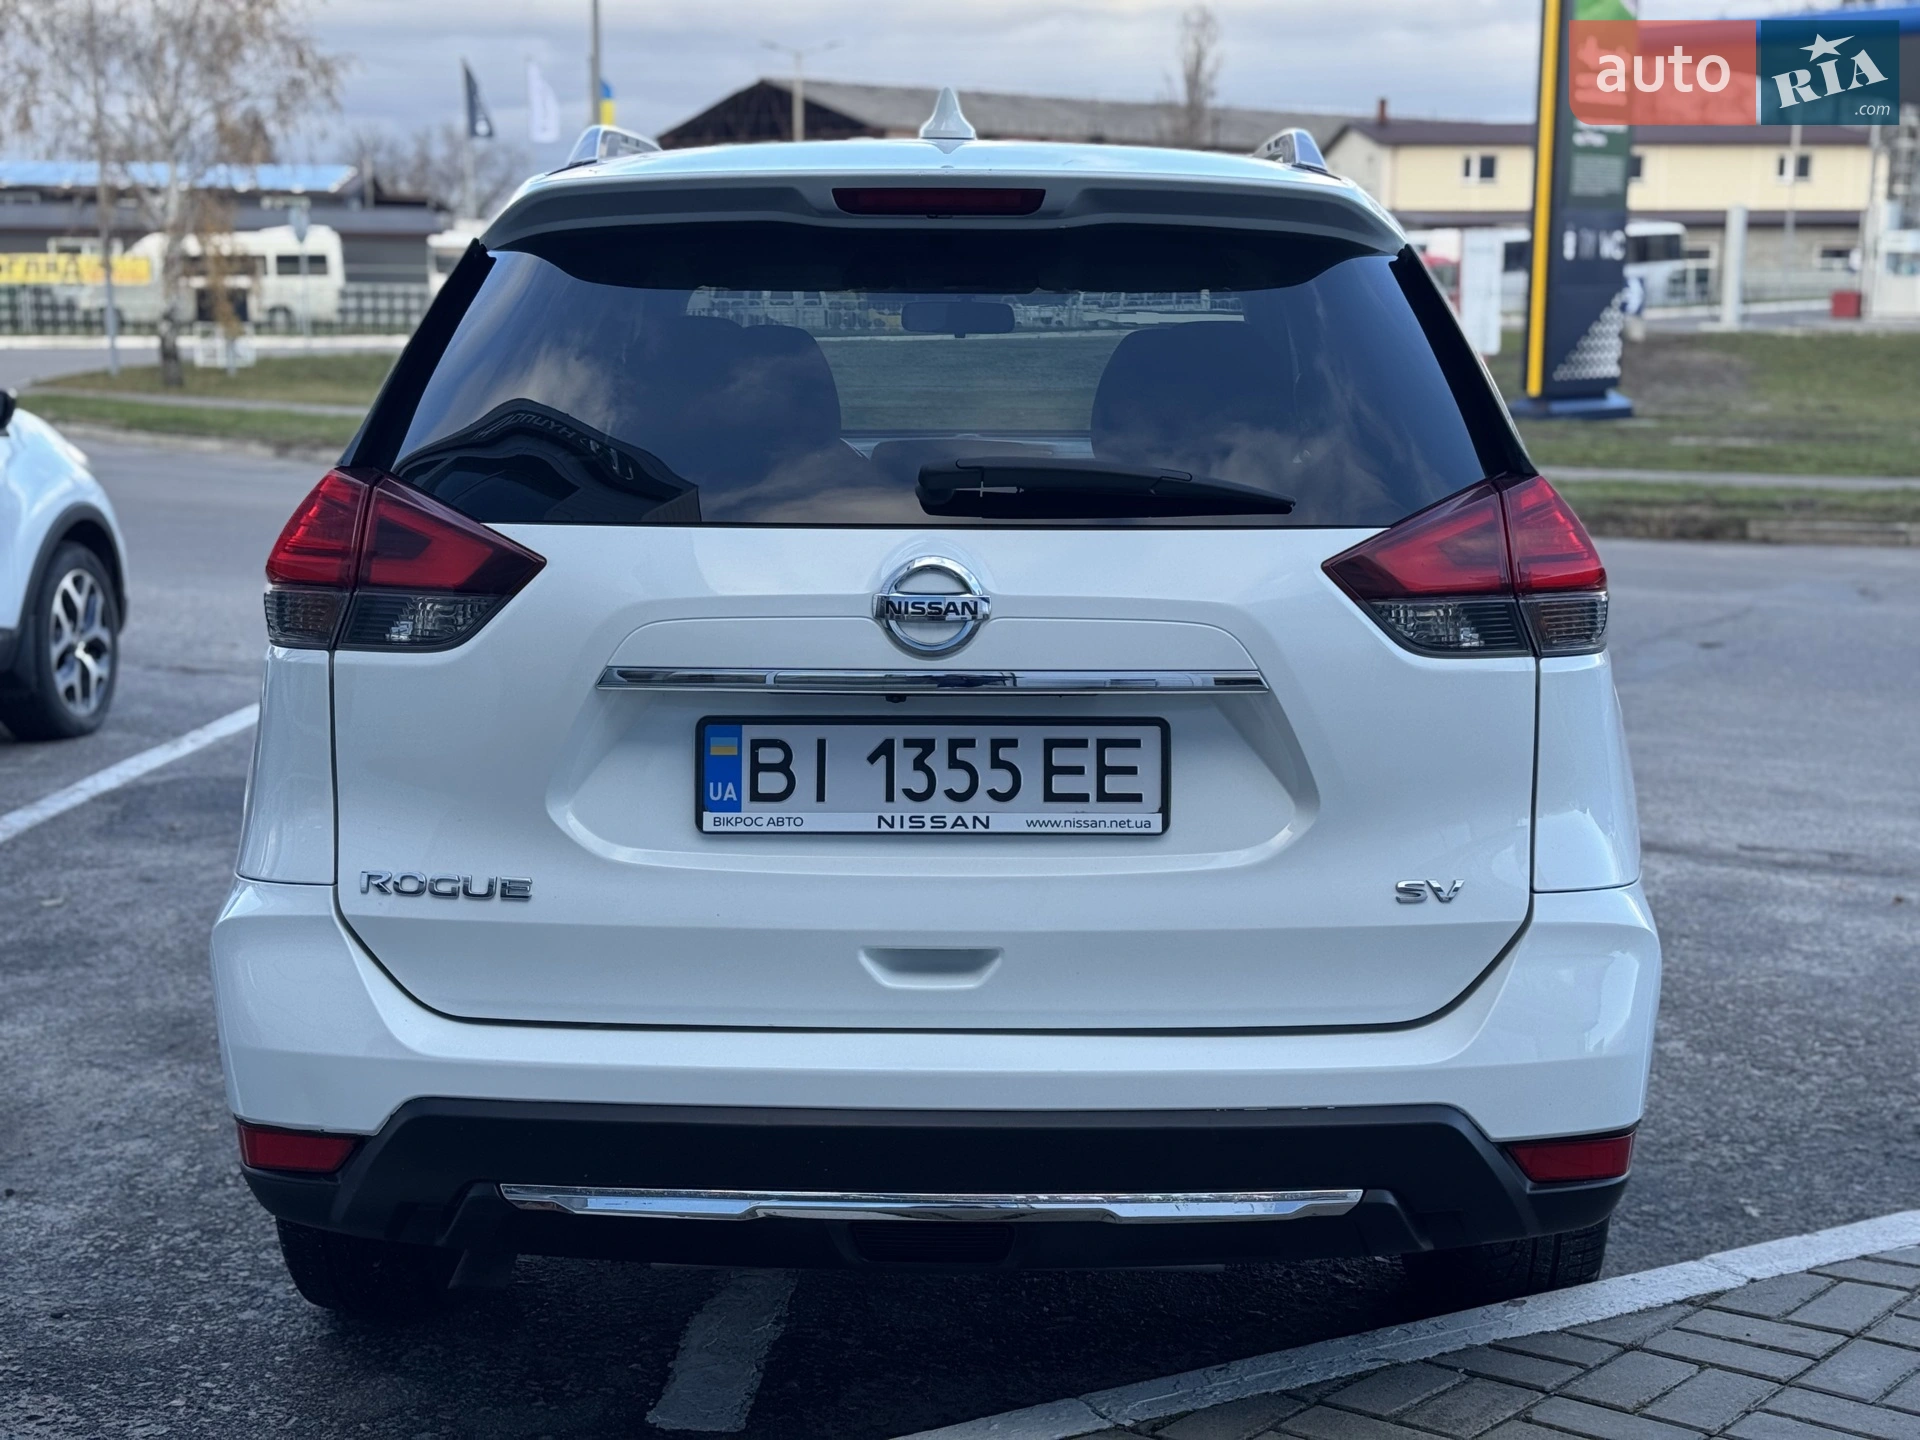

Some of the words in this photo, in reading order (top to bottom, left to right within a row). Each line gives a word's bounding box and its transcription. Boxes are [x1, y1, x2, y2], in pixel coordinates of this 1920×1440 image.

[885, 600, 979, 617] NISSAN
[749, 738, 827, 803] BI
[866, 738, 1023, 803] 1355
[1043, 738, 1144, 803] EE
[709, 782, 738, 802] UA
[713, 816, 764, 828] ВІКРОС
[766, 816, 804, 828] АВТО
[877, 815, 990, 829] NISSAN
[1025, 817, 1152, 830] www.nissan.net.ua
[360, 870, 533, 901] ROGUE
[1395, 879, 1465, 904] SV
